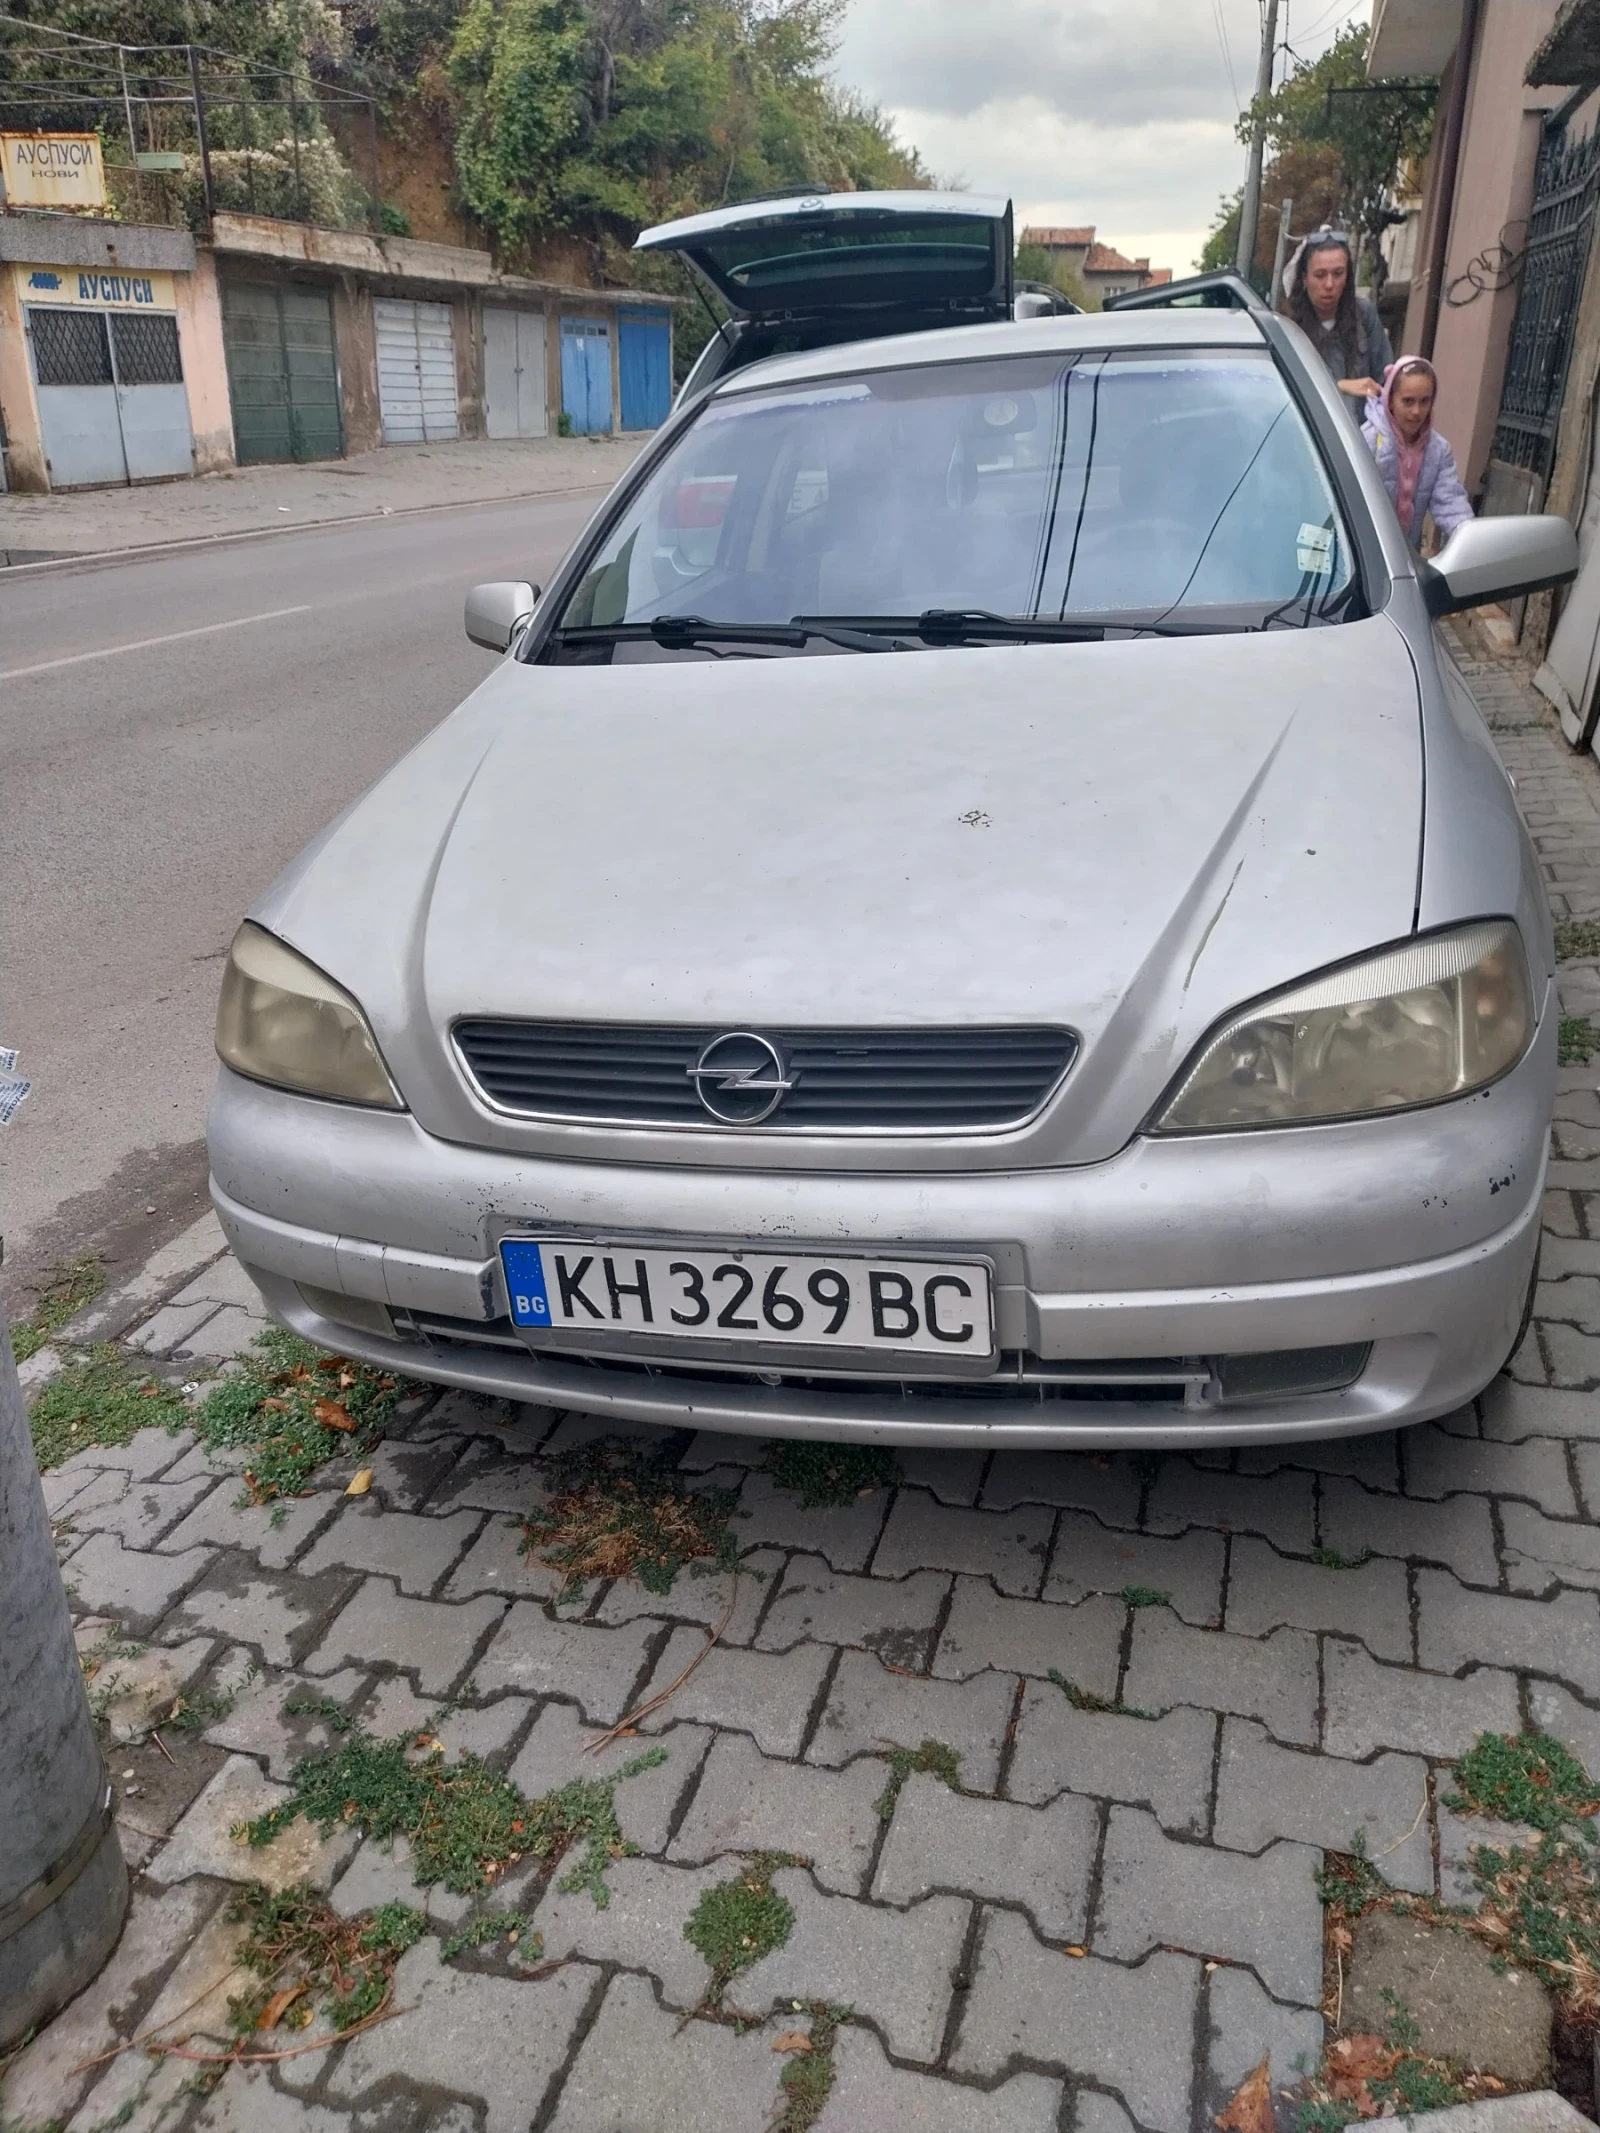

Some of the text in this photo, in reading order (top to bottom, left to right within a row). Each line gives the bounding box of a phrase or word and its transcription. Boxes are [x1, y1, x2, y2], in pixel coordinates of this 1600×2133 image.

[17, 143, 93, 166] АУСПУСИ
[31, 169, 79, 179] НОВИ
[78, 273, 154, 304] АУСПУСИ
[515, 1293, 546, 1316] BG
[669, 1262, 850, 1335] 3269
